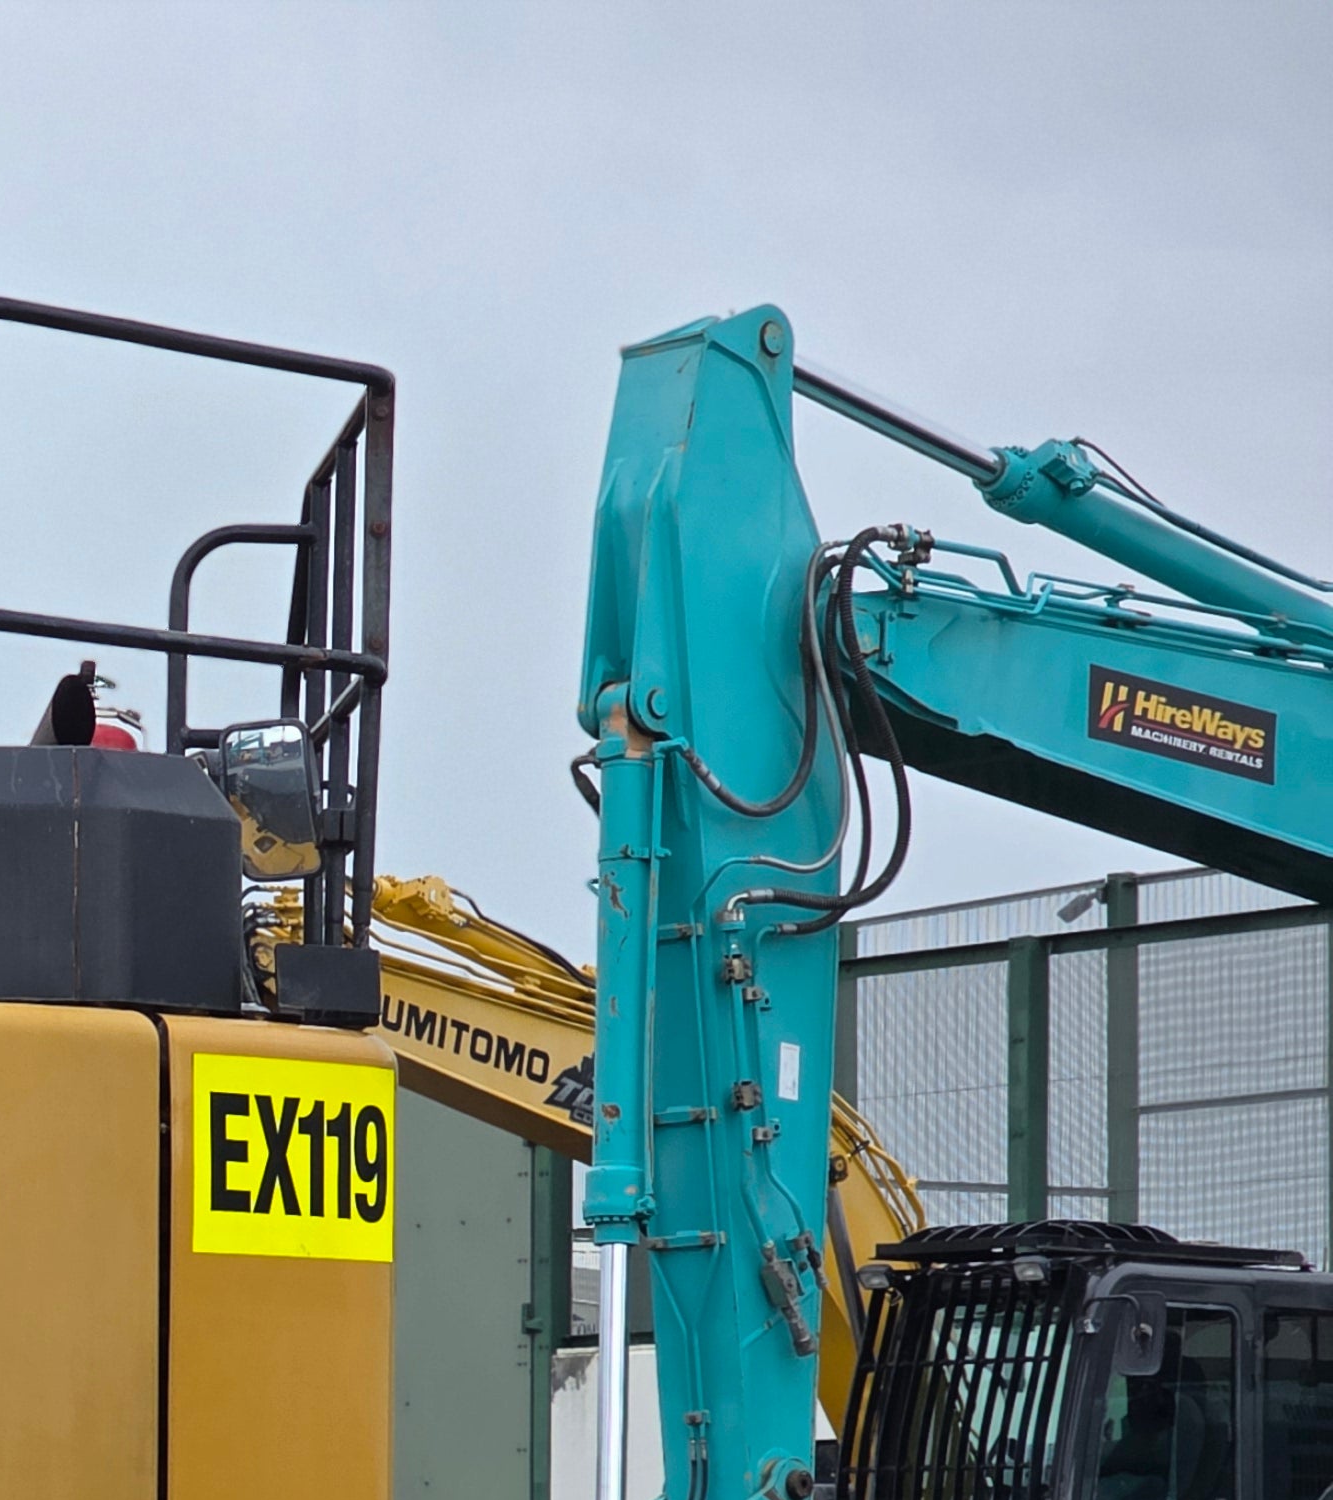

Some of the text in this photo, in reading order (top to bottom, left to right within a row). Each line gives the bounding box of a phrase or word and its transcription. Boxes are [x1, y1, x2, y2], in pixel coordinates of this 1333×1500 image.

[1130, 725, 1264, 769] MACHINERY RENTALS
[1134, 690, 1265, 749] HireWays
[379, 994, 550, 1084] UMITOMO
[209, 1091, 388, 1223] EX119
